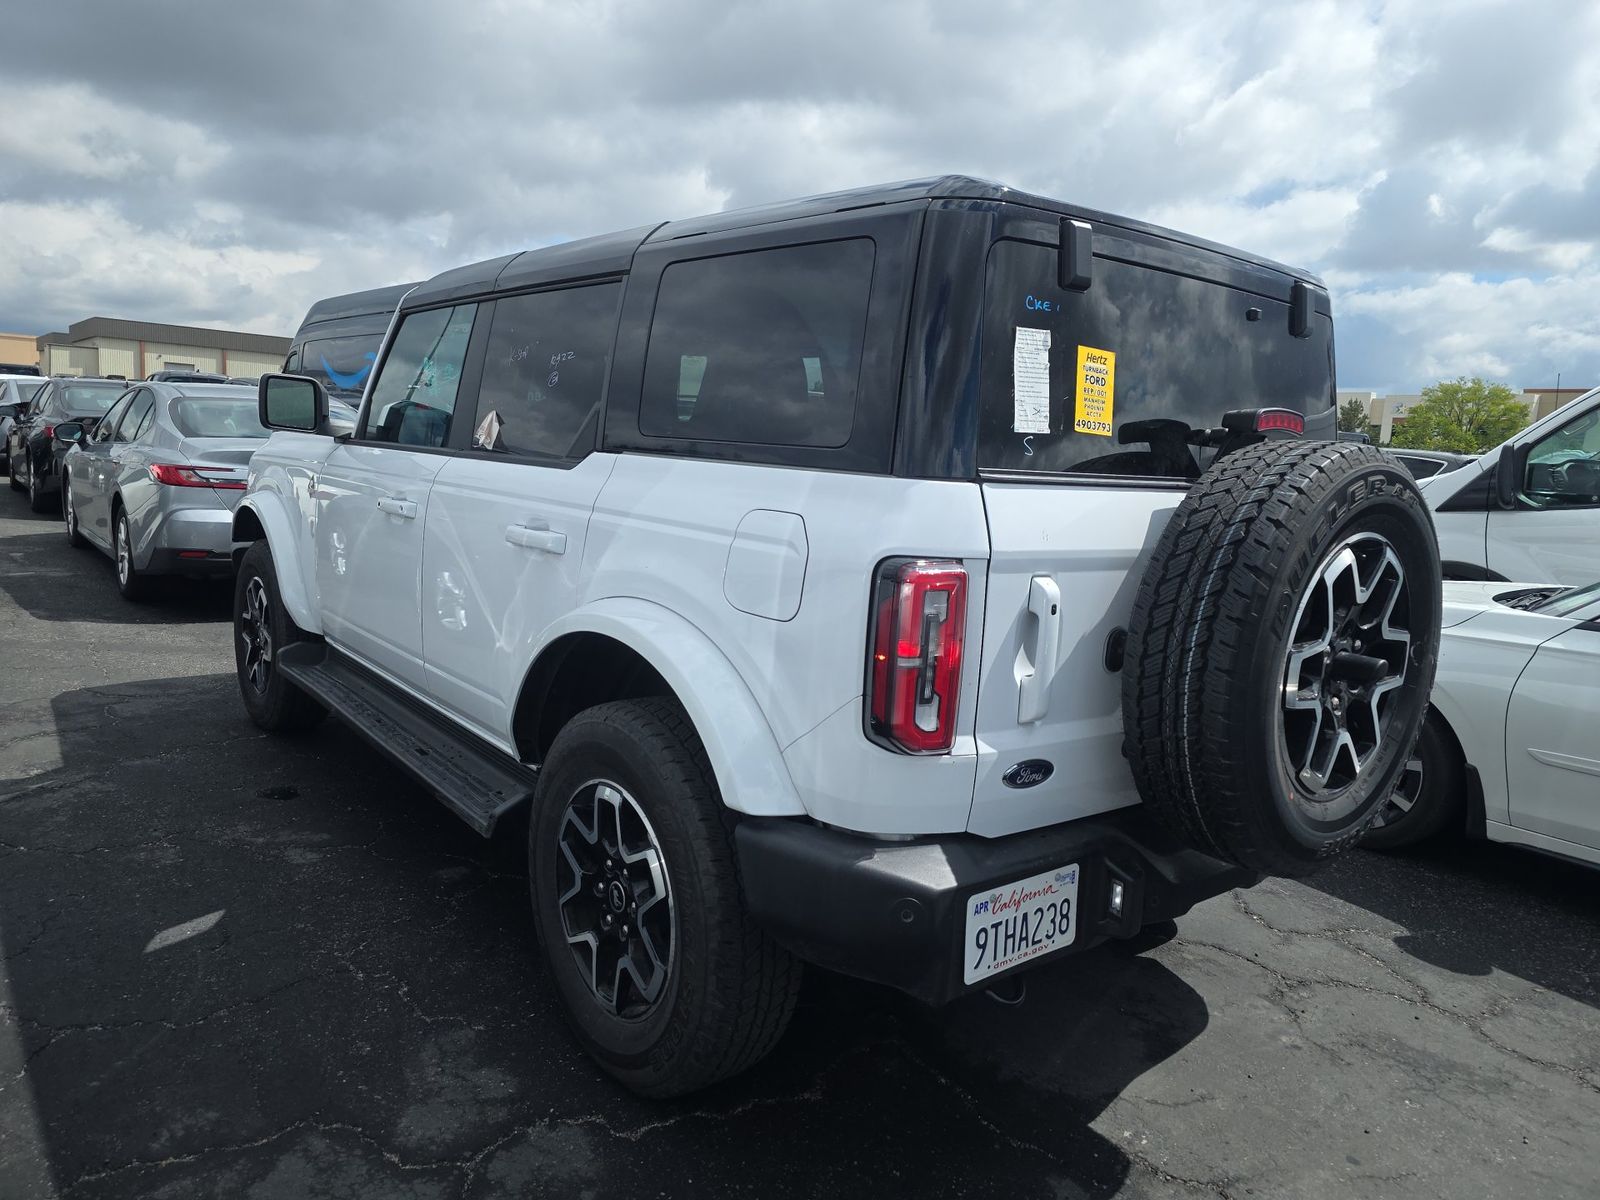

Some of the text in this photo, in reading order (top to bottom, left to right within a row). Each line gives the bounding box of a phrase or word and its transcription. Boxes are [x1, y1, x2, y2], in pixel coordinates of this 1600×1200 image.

[1086, 353, 1108, 366] Hertz
[1082, 364, 1109, 376] TURNBACK
[1084, 374, 1106, 387] FORD
[1075, 418, 1111, 433] 4903793
[1270, 473, 1389, 642] DUELER
[1017, 764, 1044, 783] Ford
[973, 880, 1060, 917] APR California
[973, 897, 1071, 970] 9THA238
[993, 942, 1050, 970] dmv.ca.gov
